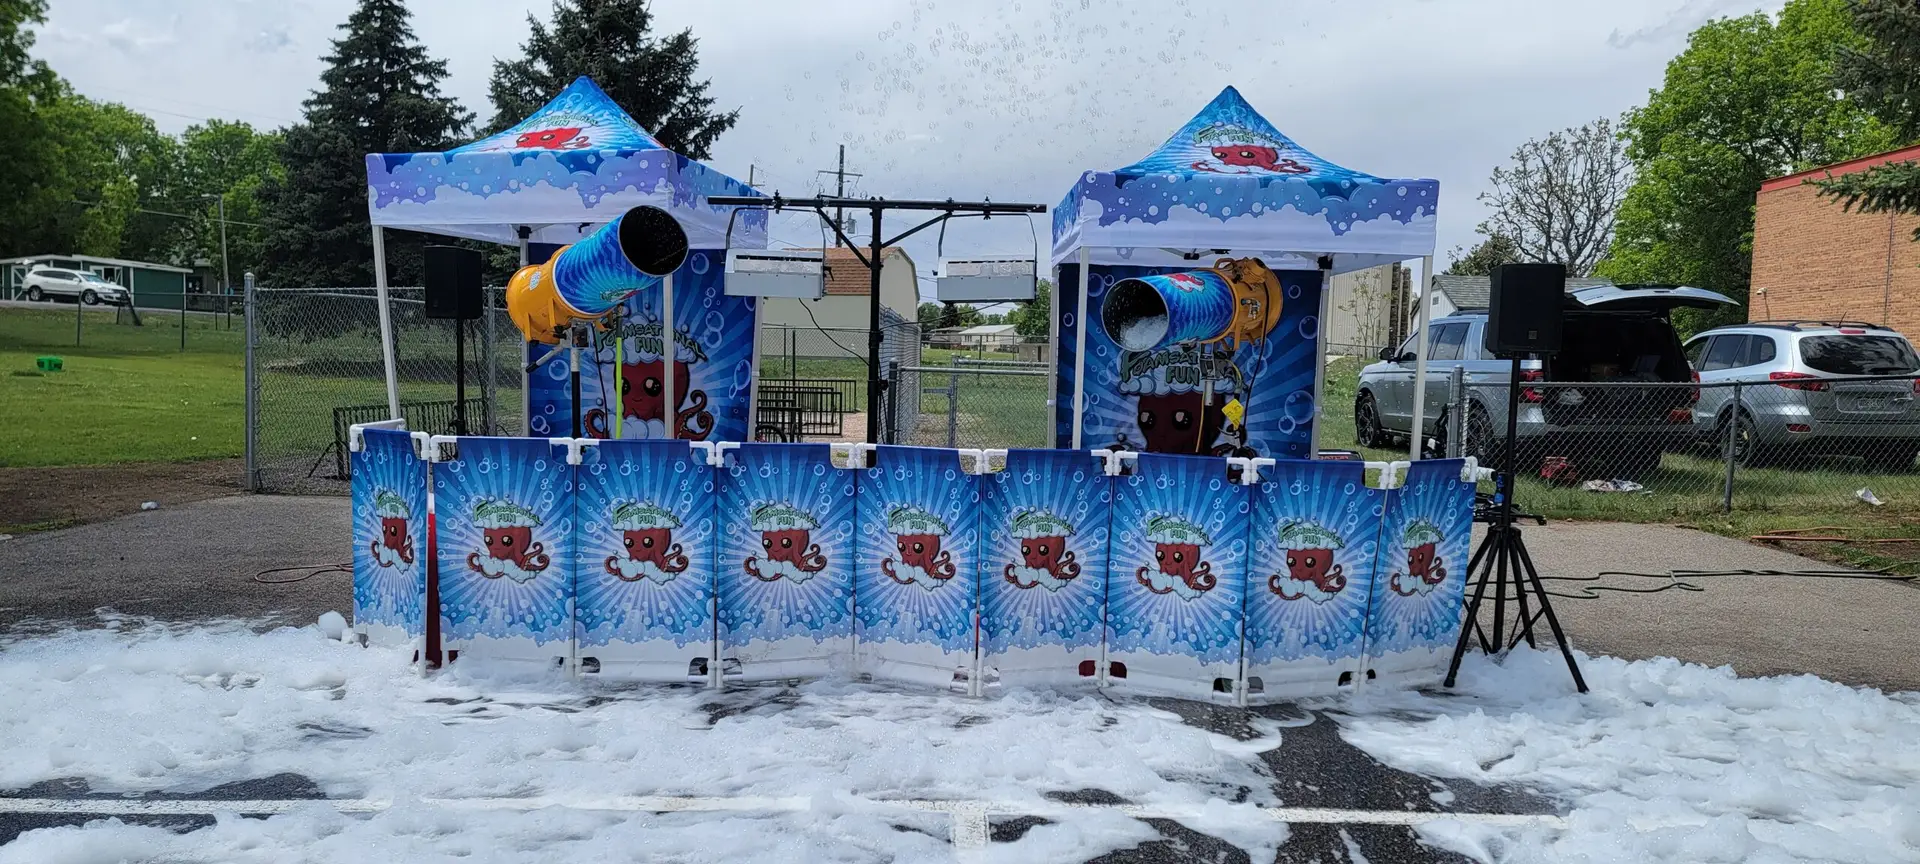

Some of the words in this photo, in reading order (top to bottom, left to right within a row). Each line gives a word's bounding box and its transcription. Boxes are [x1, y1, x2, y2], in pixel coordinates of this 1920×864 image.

[1229, 133, 1255, 144] FUN
[635, 337, 664, 356] FUN
[1166, 366, 1200, 386] FUN
[497, 513, 516, 523] FUN
[638, 515, 656, 525] FUN
[776, 516, 795, 526] FUN
[910, 520, 927, 531] FUN
[1036, 524, 1052, 533] FUN
[1170, 529, 1187, 540] FUN
[1302, 535, 1320, 545] FUN
